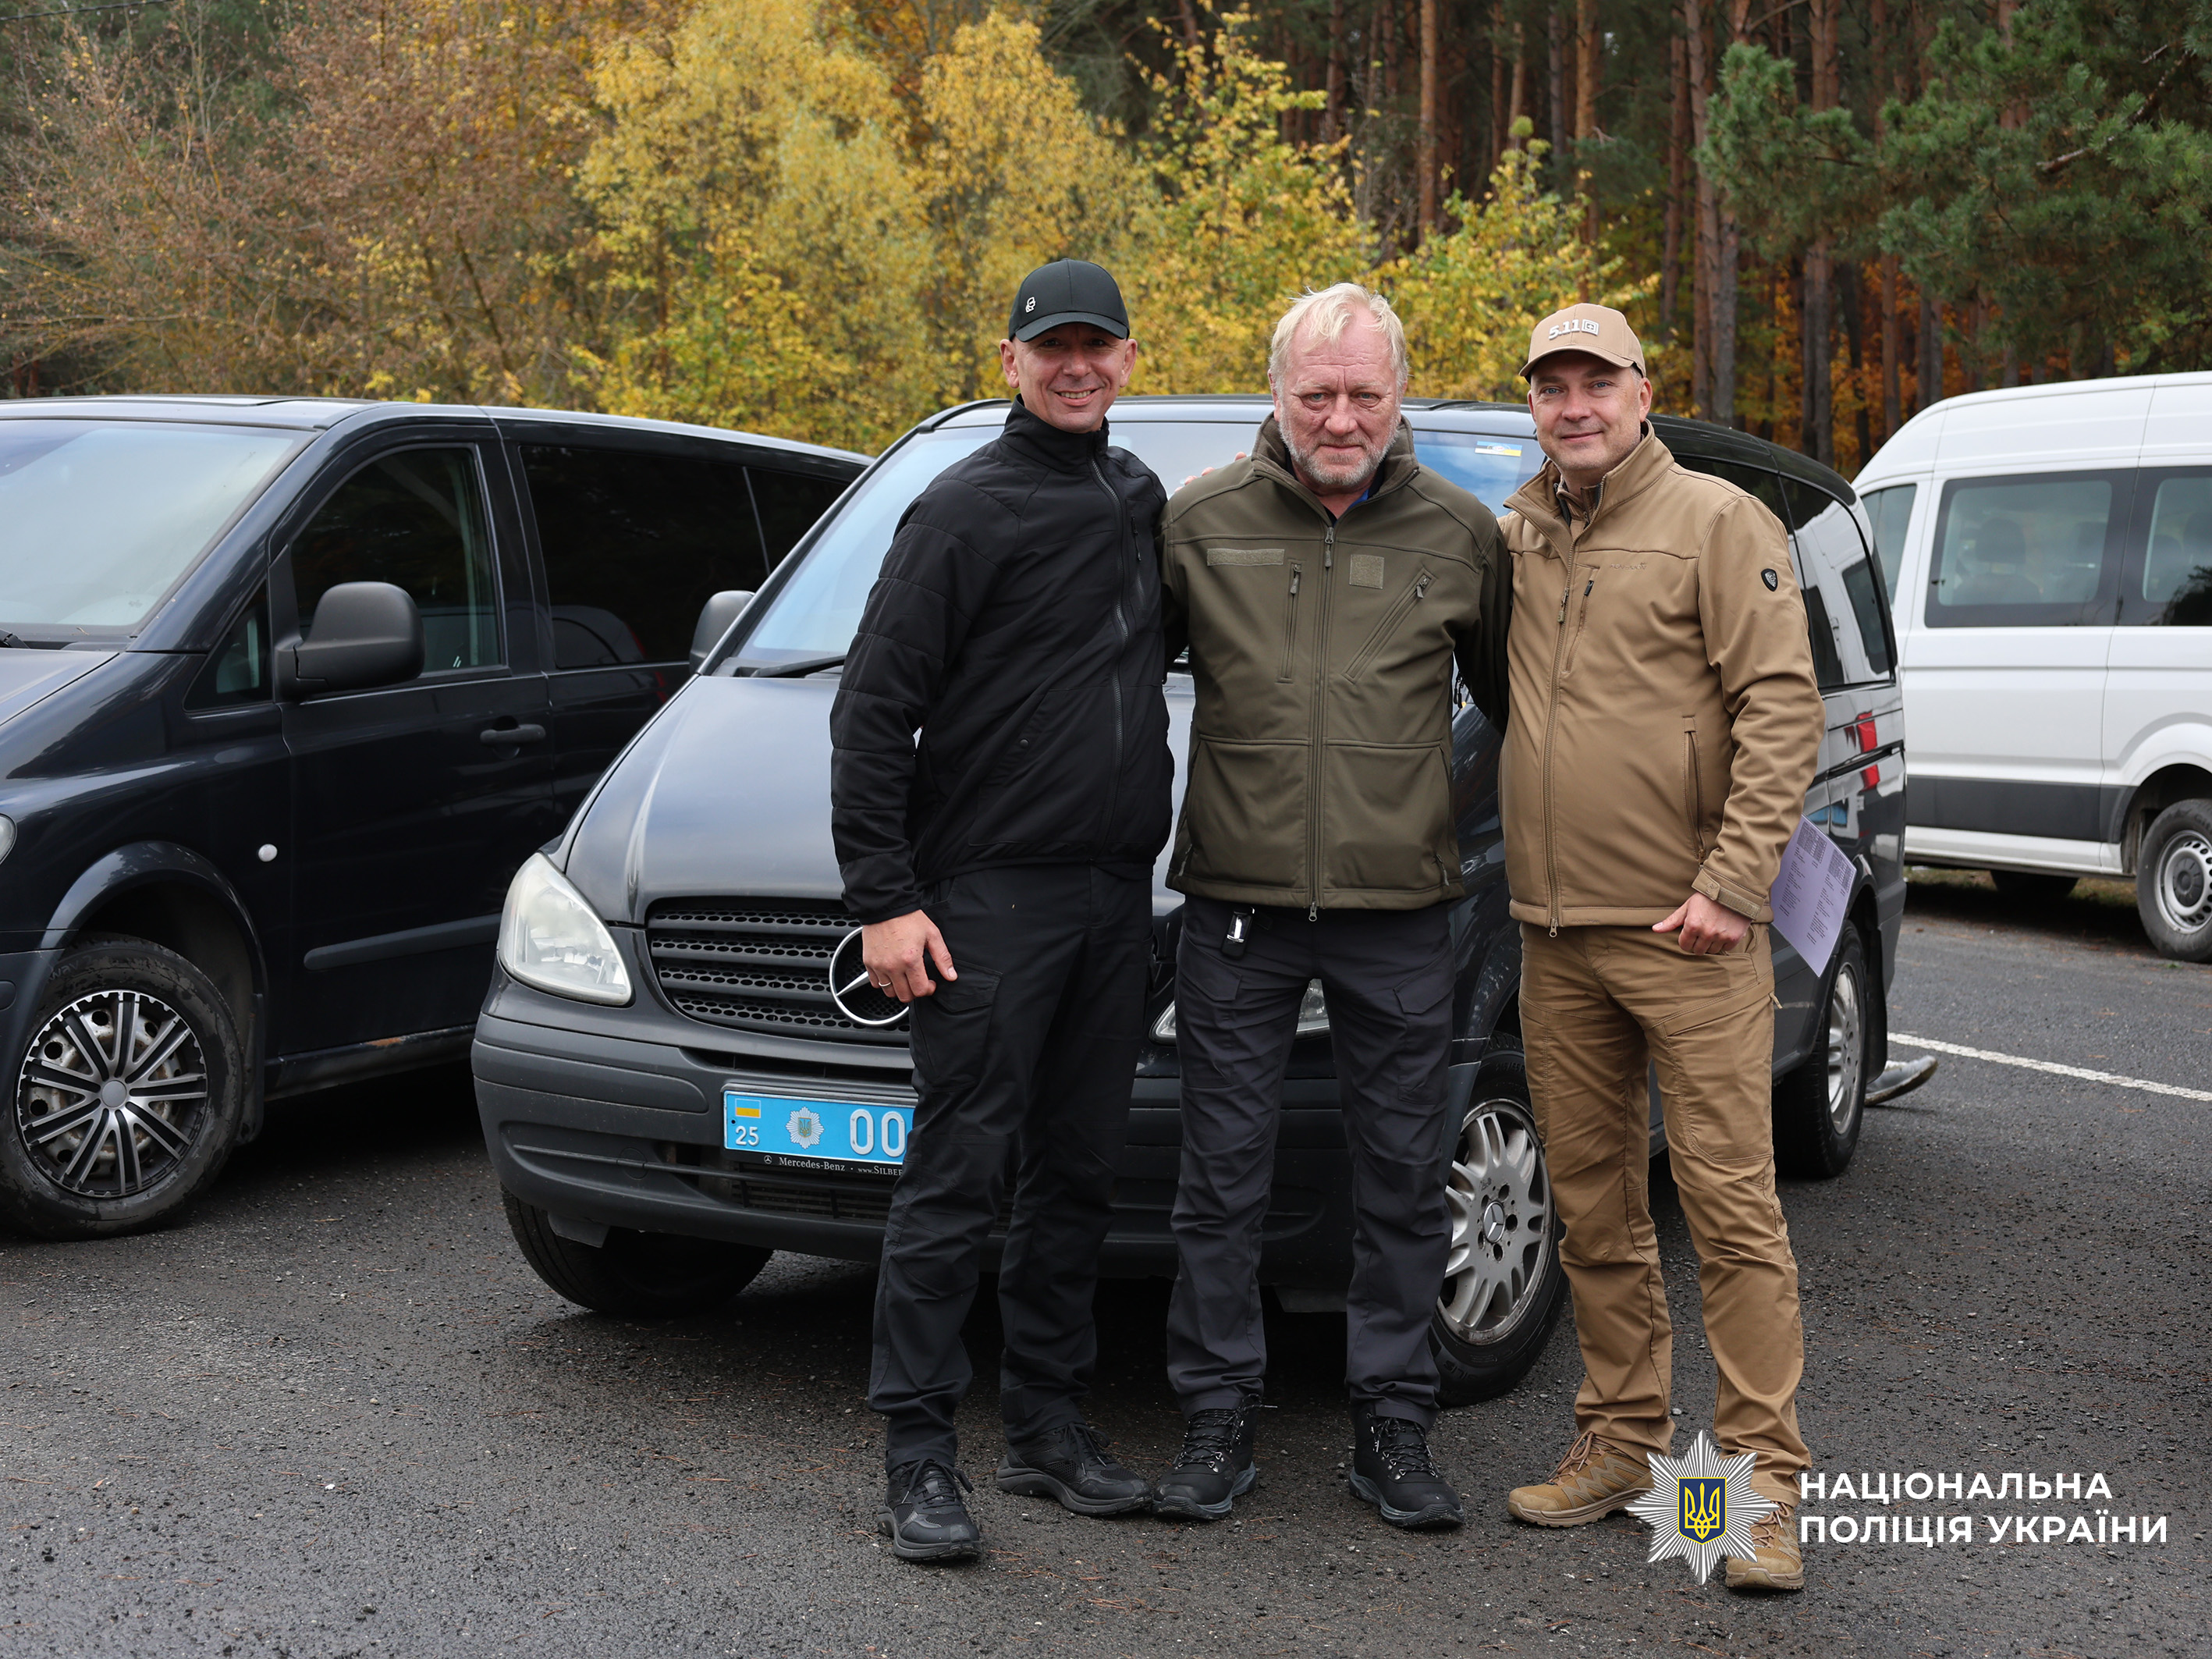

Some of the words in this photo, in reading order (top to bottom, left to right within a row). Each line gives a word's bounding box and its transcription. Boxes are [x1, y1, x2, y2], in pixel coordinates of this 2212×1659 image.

[1548, 319, 1581, 340] 5.11
[735, 1125, 760, 1146] 25
[779, 1156, 846, 1171] Mercedes-Benz
